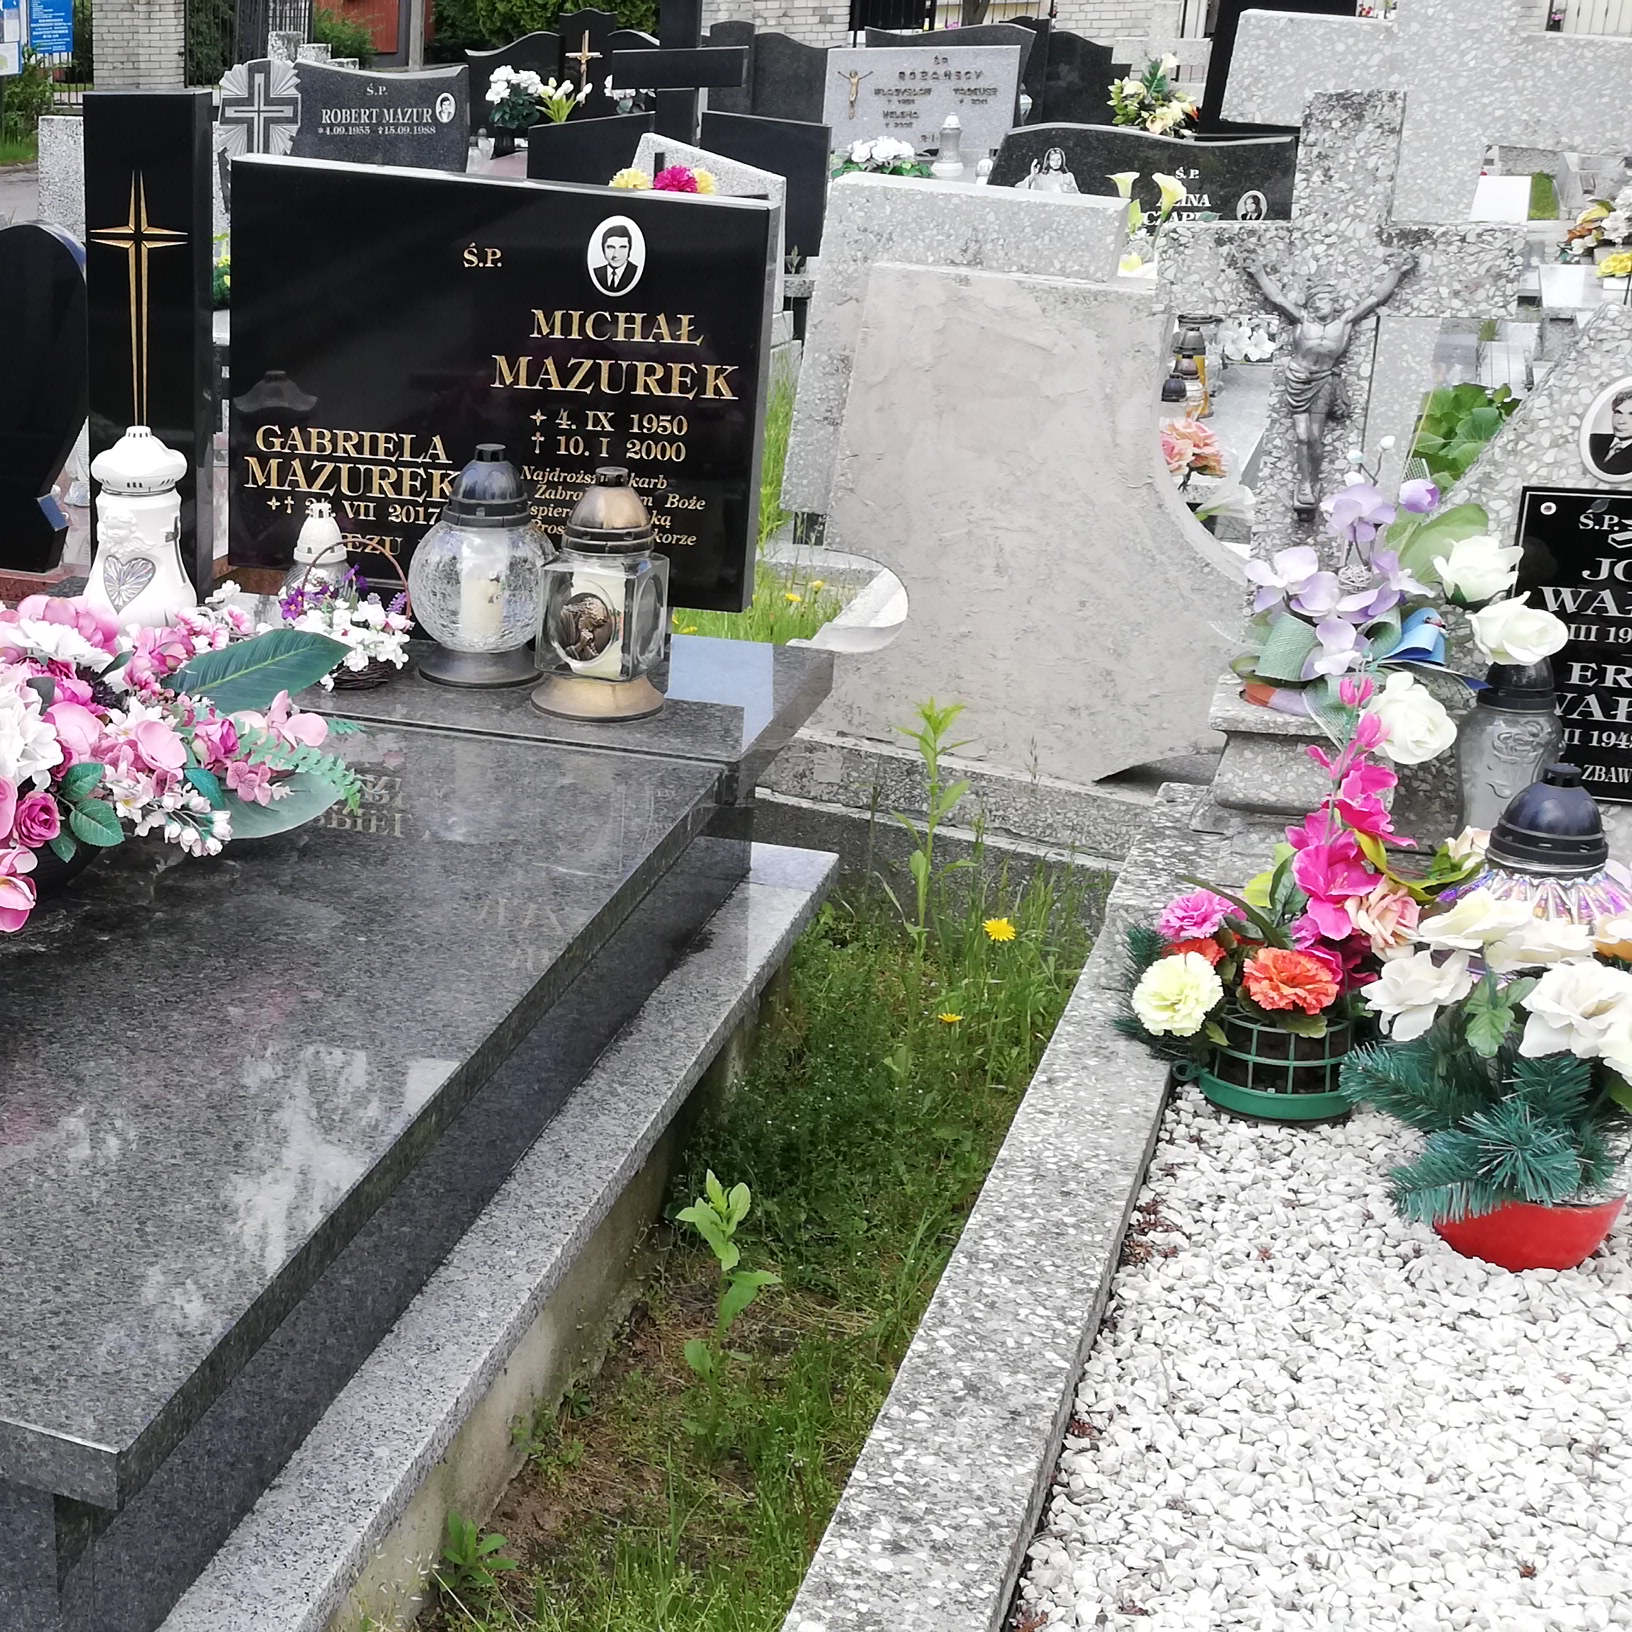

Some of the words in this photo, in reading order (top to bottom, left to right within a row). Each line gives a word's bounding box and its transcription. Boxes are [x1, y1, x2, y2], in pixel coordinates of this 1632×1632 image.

[321, 108, 379, 124] ROBERT
[382, 107, 432, 124] MAZUR
[463, 242, 503, 268] Ś.P.
[530, 308, 704, 346] MICHAŁ
[490, 354, 739, 401] MAZUREK
[555, 407, 577, 430] 4.
[585, 410, 615, 432] IX
[628, 413, 689, 436] 1950
[255, 424, 453, 464] GABRIELA
[556, 435, 590, 456] 10.
[626, 439, 687, 462] 2000
[243, 456, 463, 503] MAZUREK
[341, 499, 377, 521] VII
[388, 503, 442, 526] 2017
[665, 493, 707, 511] Boże
[341, 532, 404, 556] EZU
